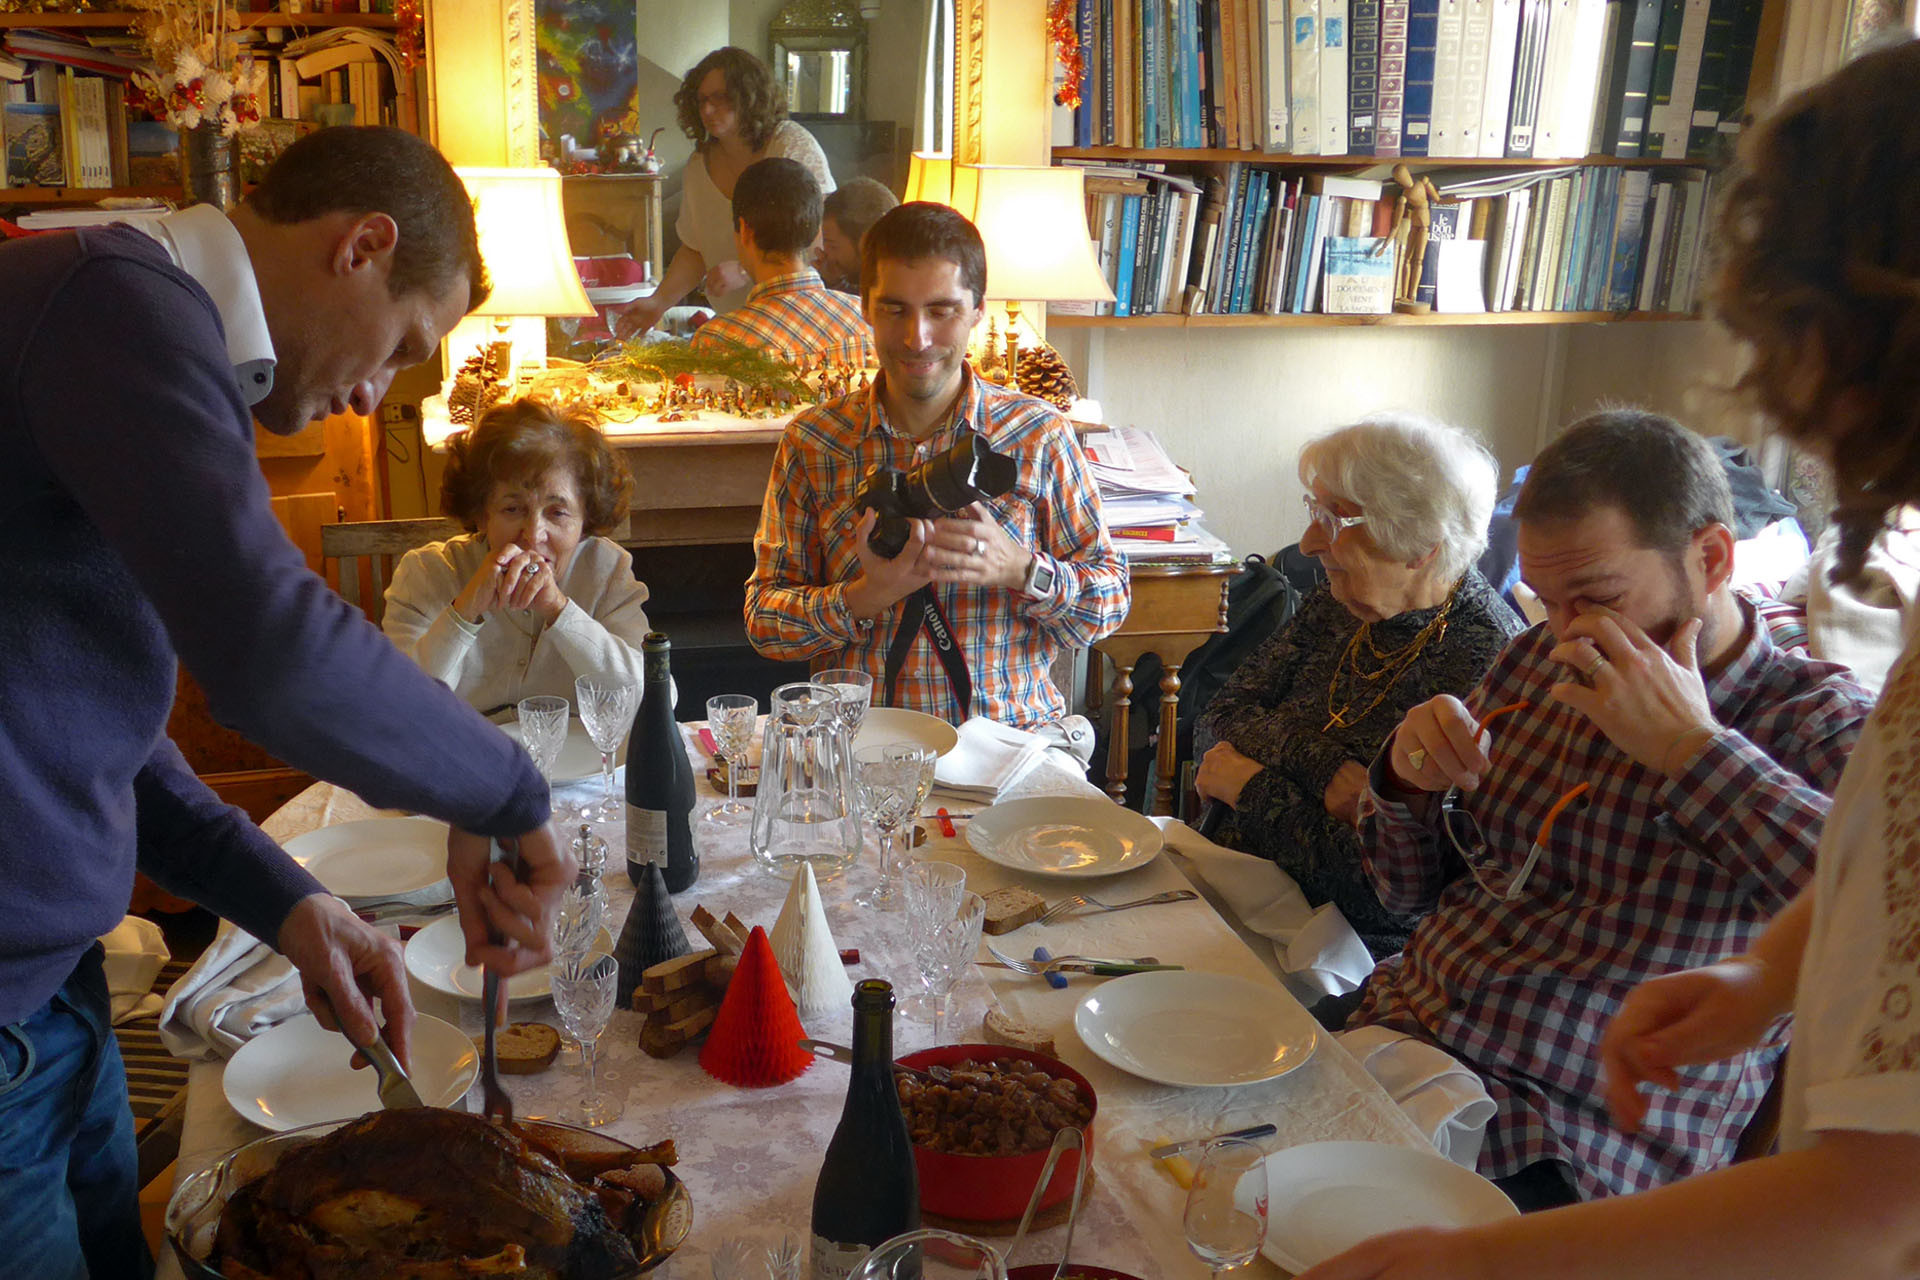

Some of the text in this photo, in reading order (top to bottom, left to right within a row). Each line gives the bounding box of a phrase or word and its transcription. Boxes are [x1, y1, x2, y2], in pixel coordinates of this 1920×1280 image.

[1082, 11, 1093, 49] ATLAS
[1146, 52, 1154, 62] LA
[1146, 63, 1154, 73] ET
[1146, 73, 1154, 105] MATISSE
[1439, 213, 1448, 225] le
[1432, 221, 1452, 234] bon
[925, 603, 952, 651] Canon
